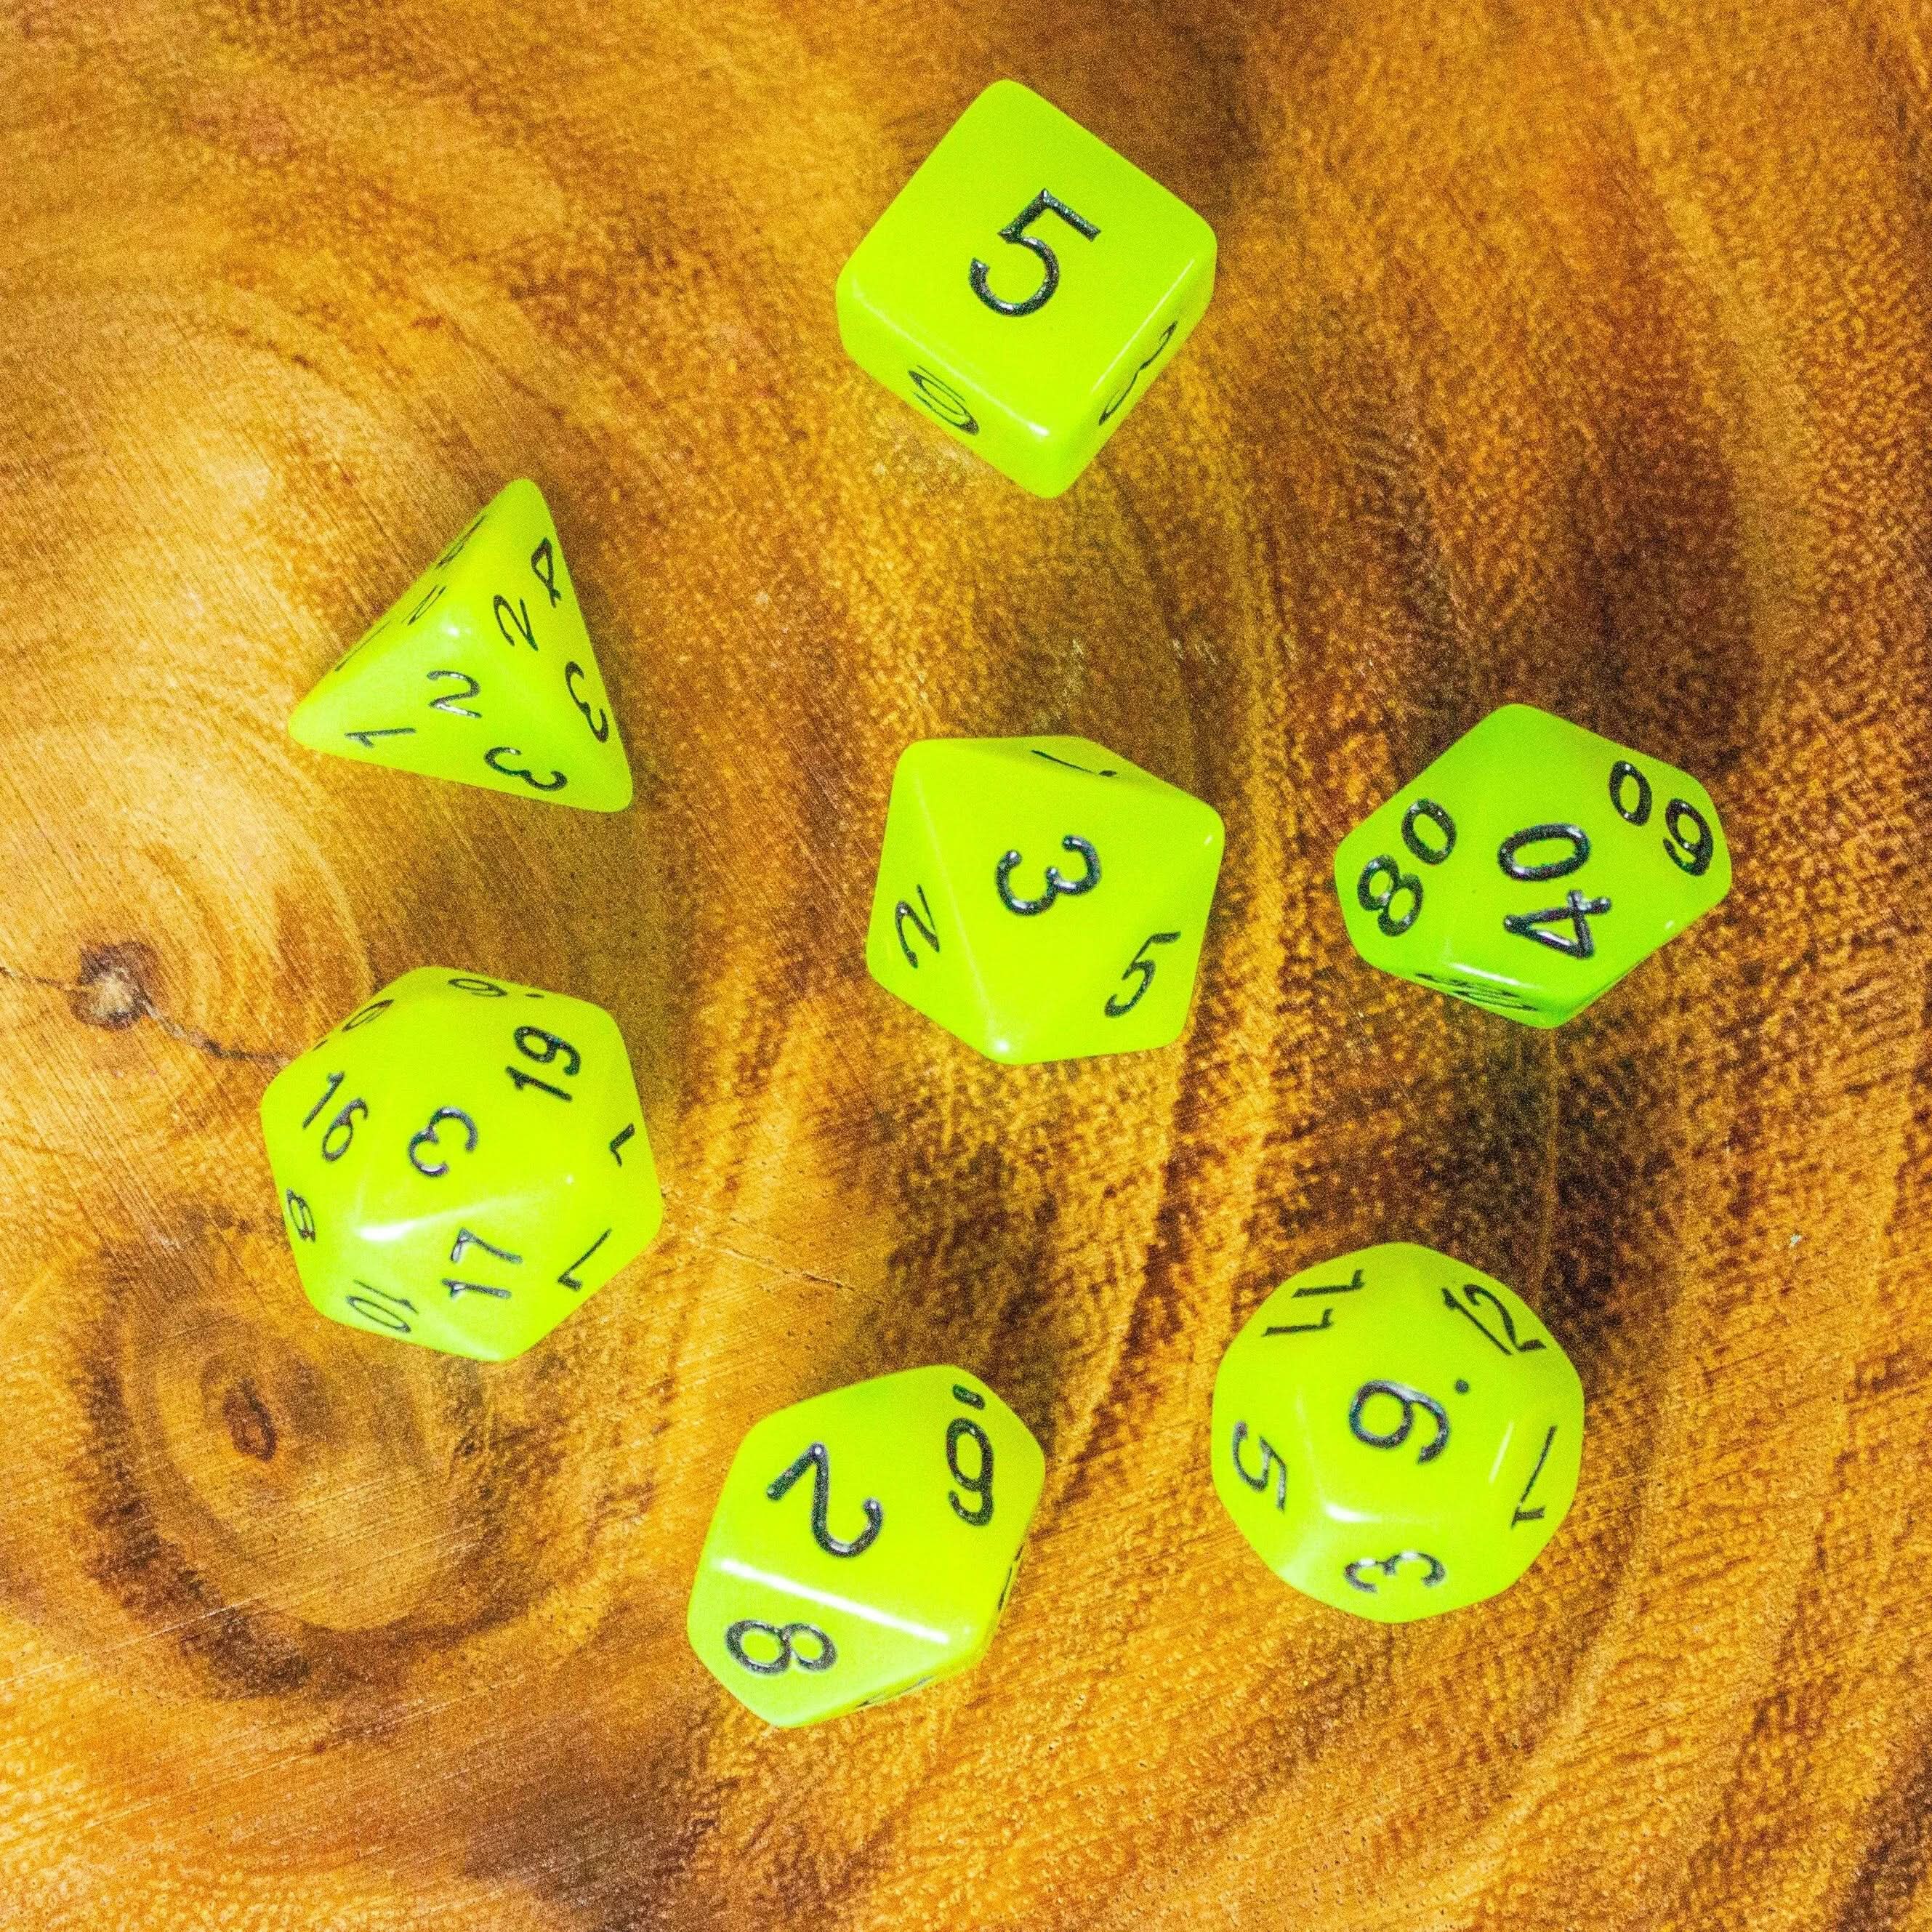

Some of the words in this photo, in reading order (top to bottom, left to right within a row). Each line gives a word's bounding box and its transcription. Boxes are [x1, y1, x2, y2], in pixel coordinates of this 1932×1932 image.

[969, 188, 1101, 318] 5
[531, 536, 563, 608] 4
[493, 594, 539, 651] 2
[426, 669, 483, 719] 2
[564, 660, 610, 744] 3
[344, 727, 416, 749] 1
[483, 746, 568, 792] 3
[995, 834, 1102, 917] 3
[1356, 798, 1458, 938] 80
[1496, 822, 1613, 960] 40
[895, 883, 940, 969] 2
[1104, 930, 1181, 1018] 5
[505, 1025, 582, 1103] 19
[302, 1070, 369, 1163] 16
[408, 1106, 479, 1178] 3
[286, 1188, 316, 1244] 8
[441, 1227, 523, 1300] 17
[557, 1228, 612, 1292] 7
[346, 1279, 419, 1335] 10
[1261, 1269, 1366, 1338] 11
[1441, 1284, 1547, 1356] 12
[765, 1441, 884, 1559] 2
[1232, 1420, 1287, 1512] 5
[1344, 1550, 1447, 1594] 3
[725, 1619, 838, 1676] 8
